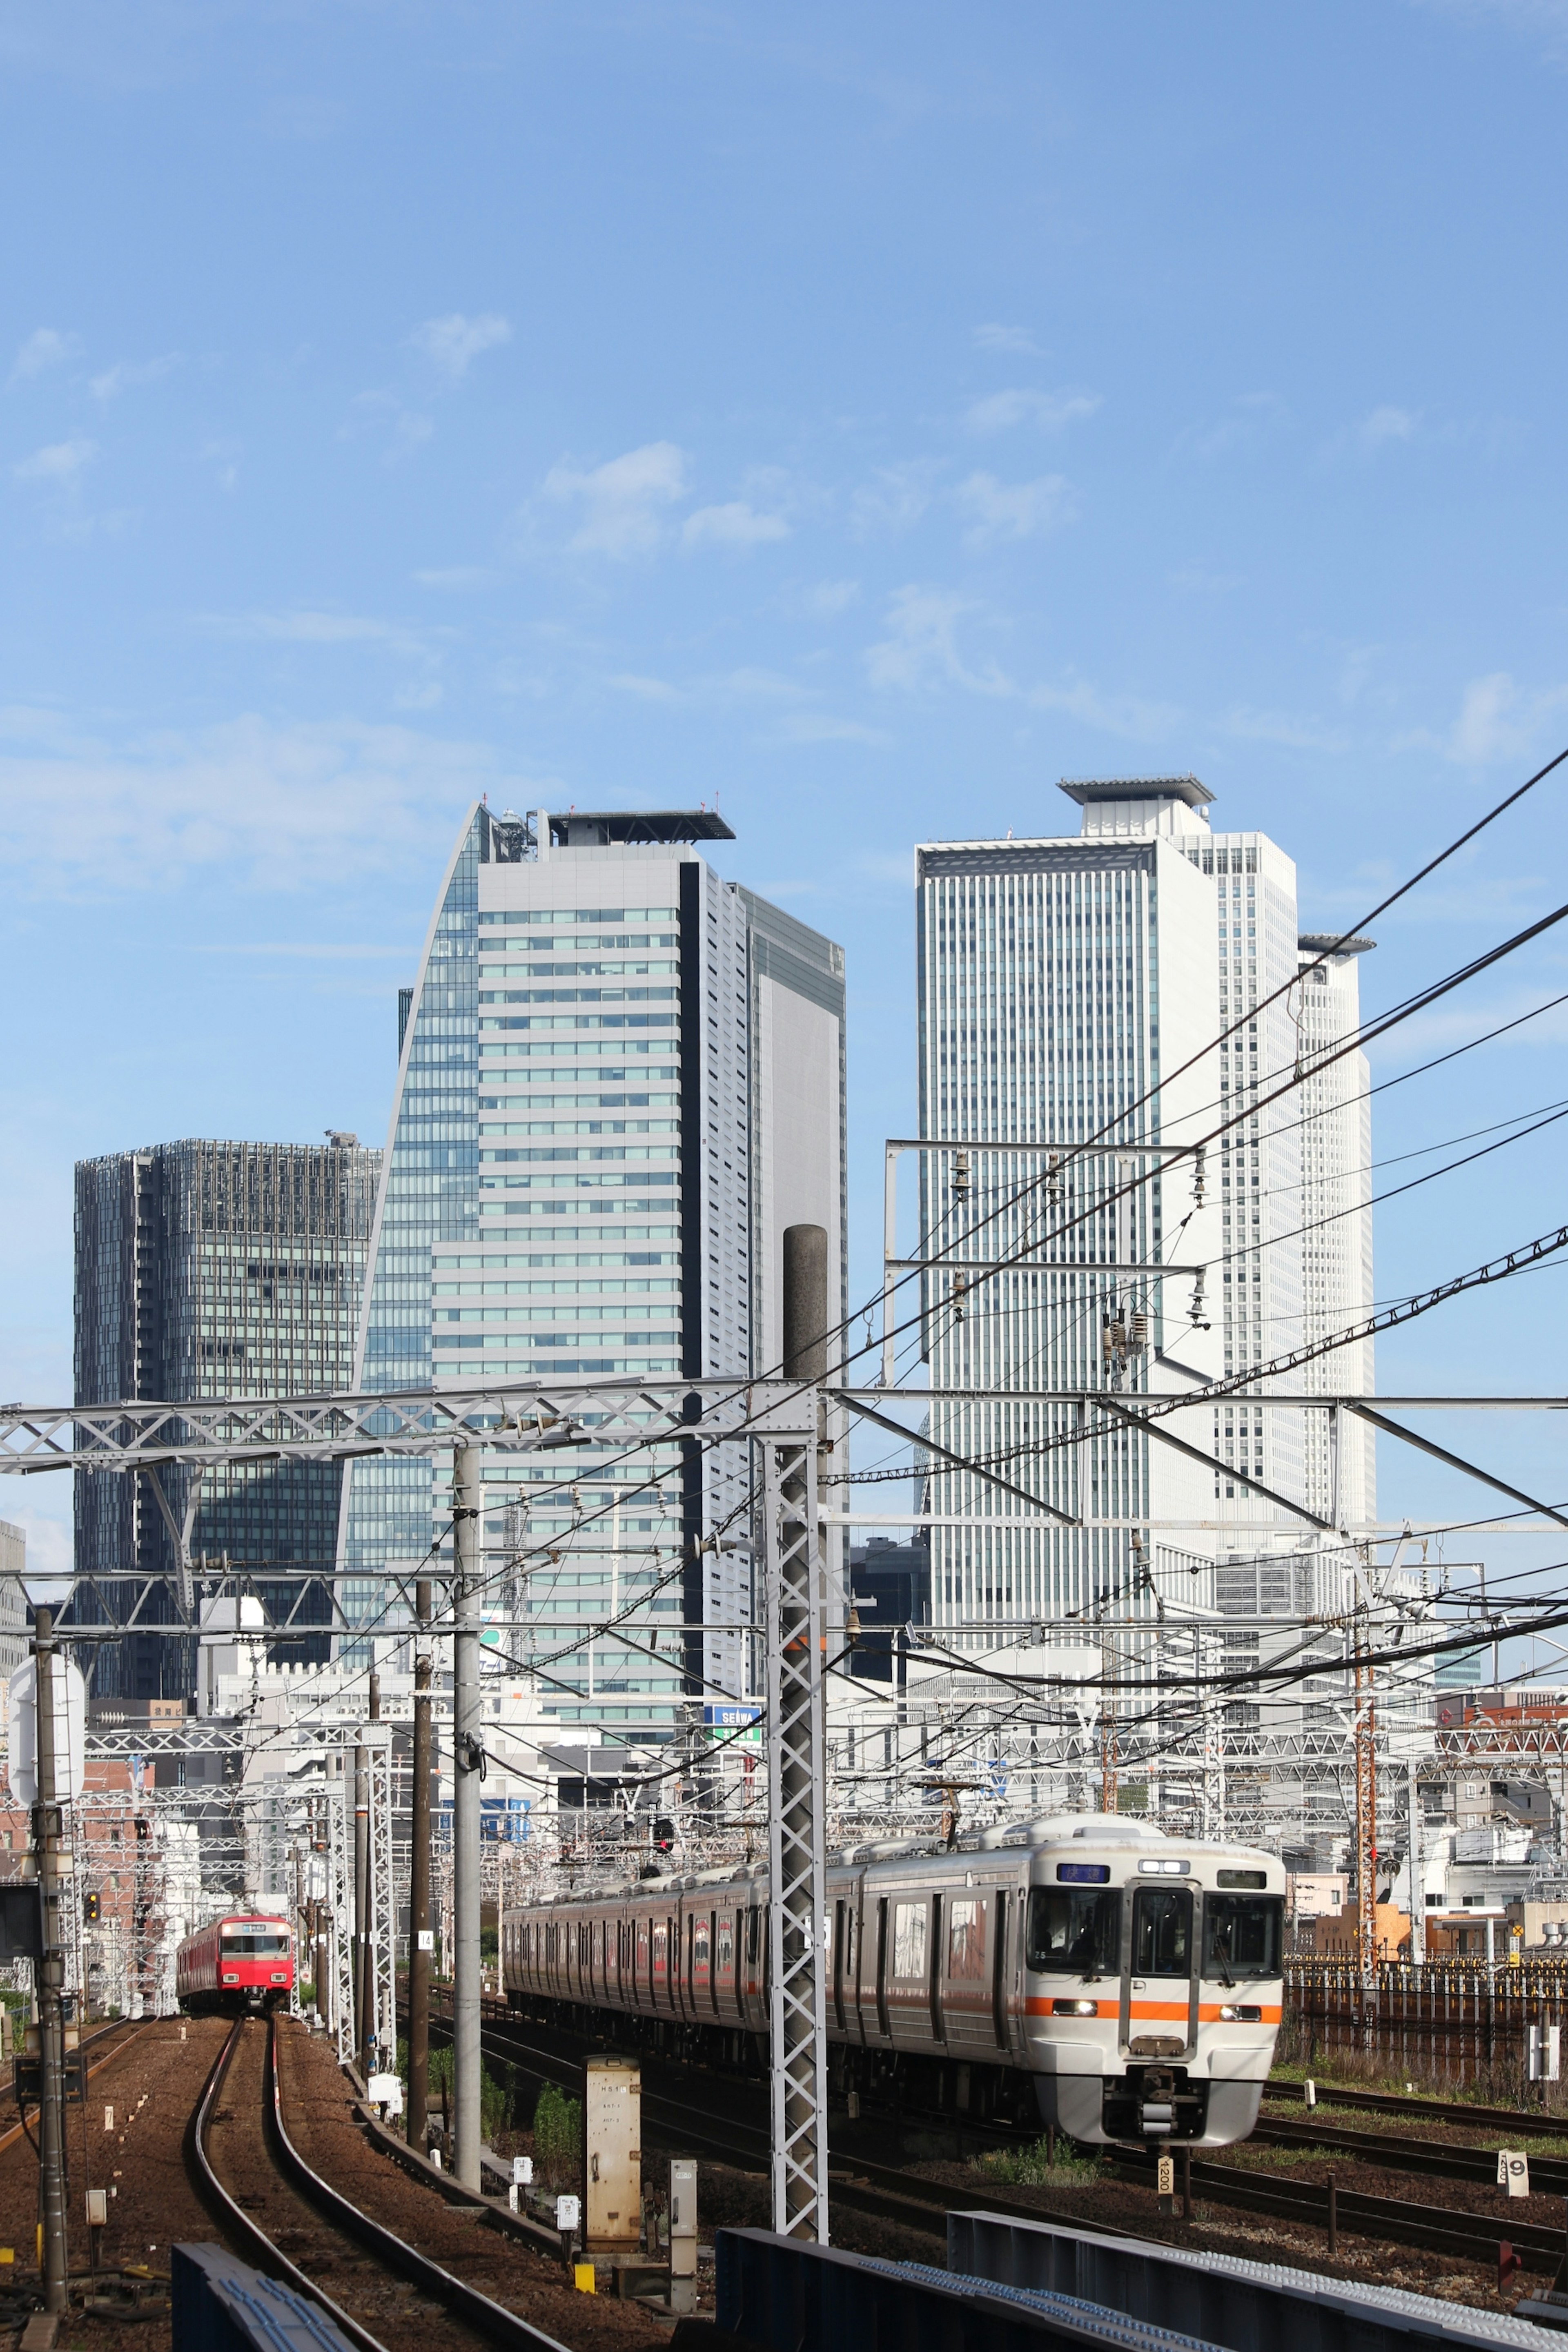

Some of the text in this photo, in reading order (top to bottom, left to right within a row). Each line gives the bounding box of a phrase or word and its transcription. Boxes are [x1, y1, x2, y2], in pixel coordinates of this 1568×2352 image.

[722, 1708, 753, 1724] SEIWA
[1066, 1865, 1100, 1880] 快速
[423, 1935, 430, 1945] 14
[107, 2111, 112, 2123] 7
[1160, 2161, 1169, 2190] 1200
[1510, 2160, 1525, 2176] 9
